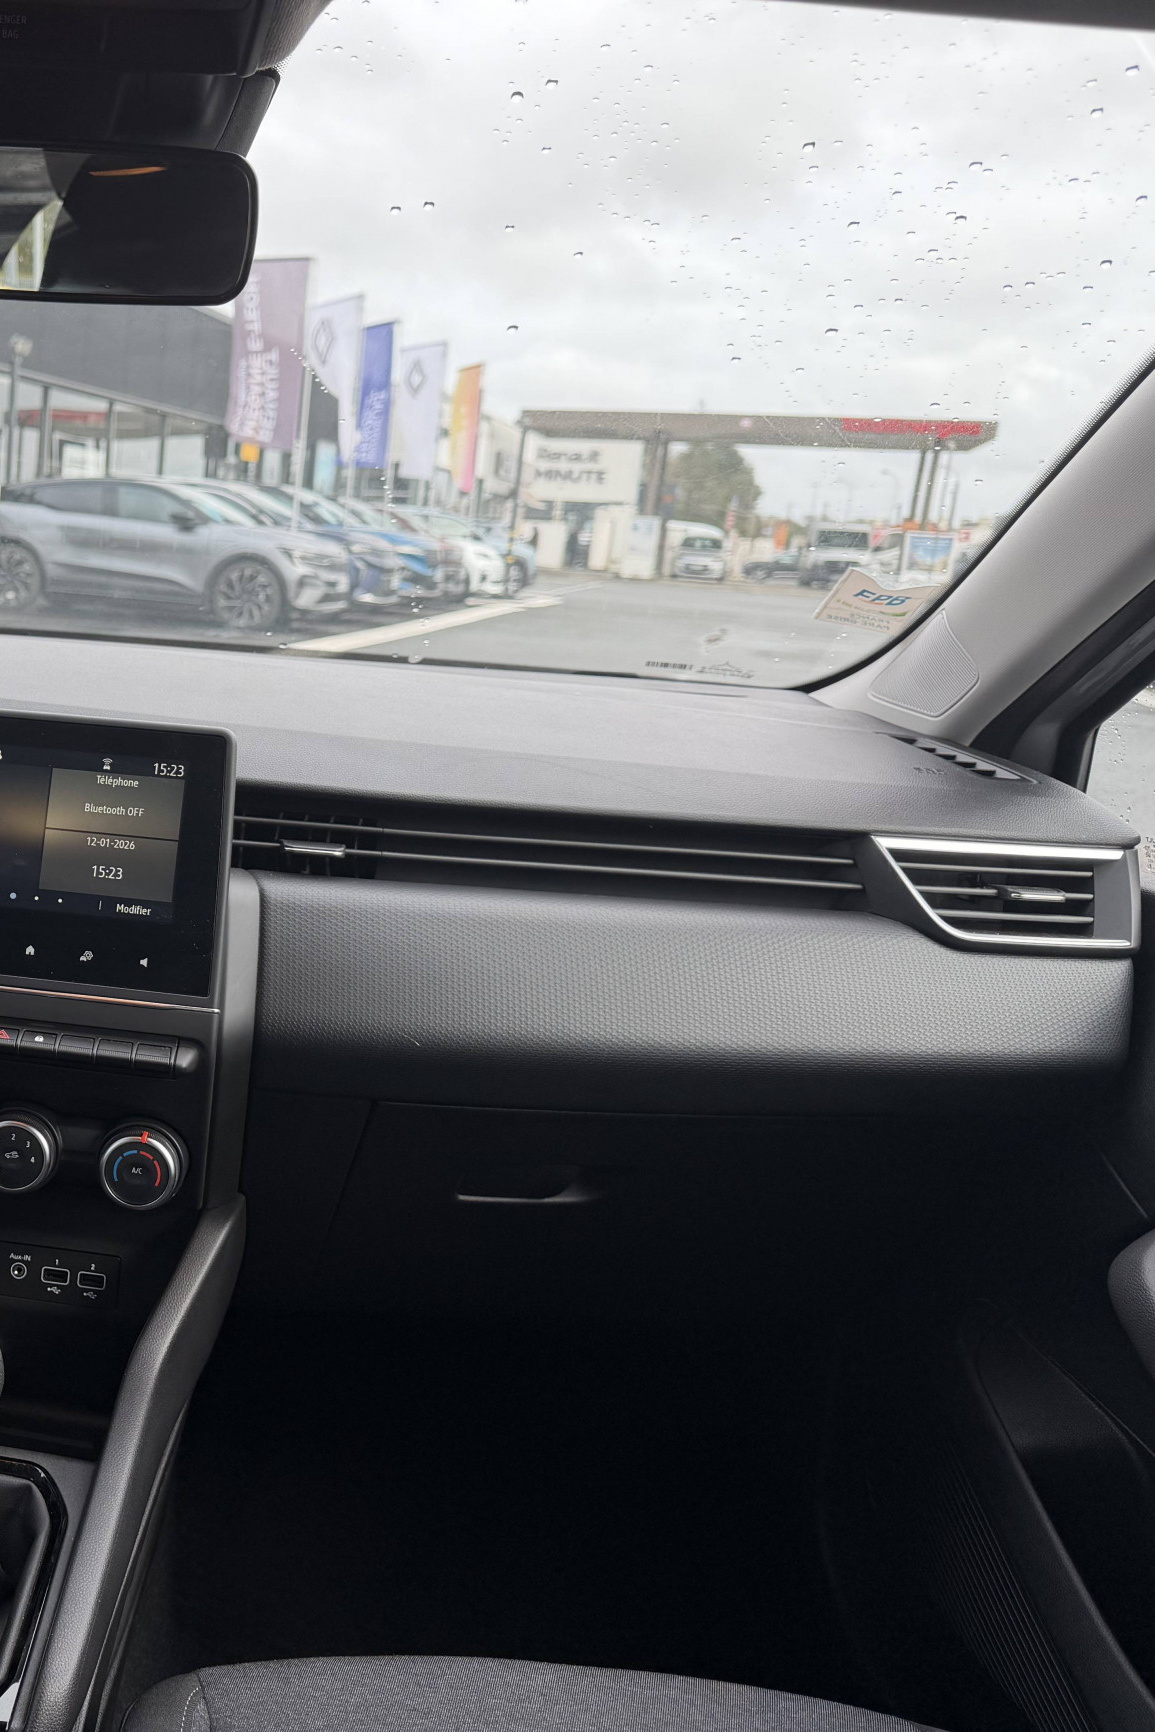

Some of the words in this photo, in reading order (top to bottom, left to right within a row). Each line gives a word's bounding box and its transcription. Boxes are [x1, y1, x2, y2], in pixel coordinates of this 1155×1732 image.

[2, 29, 19, 39] BAG
[535, 469, 606, 485] MINUTE
[153, 763, 185, 777] 15:23
[96, 775, 139, 788] Téléphone
[84, 803, 126, 816] Bluetooth
[127, 807, 145, 817] OFF
[86, 837, 135, 850] 12-01-2026
[92, 865, 123, 880] 15:23
[116, 903, 152, 916] Modifier
[131, 1167, 143, 1175] A/C
[9, 1252, 31, 1262] Aux-IN
